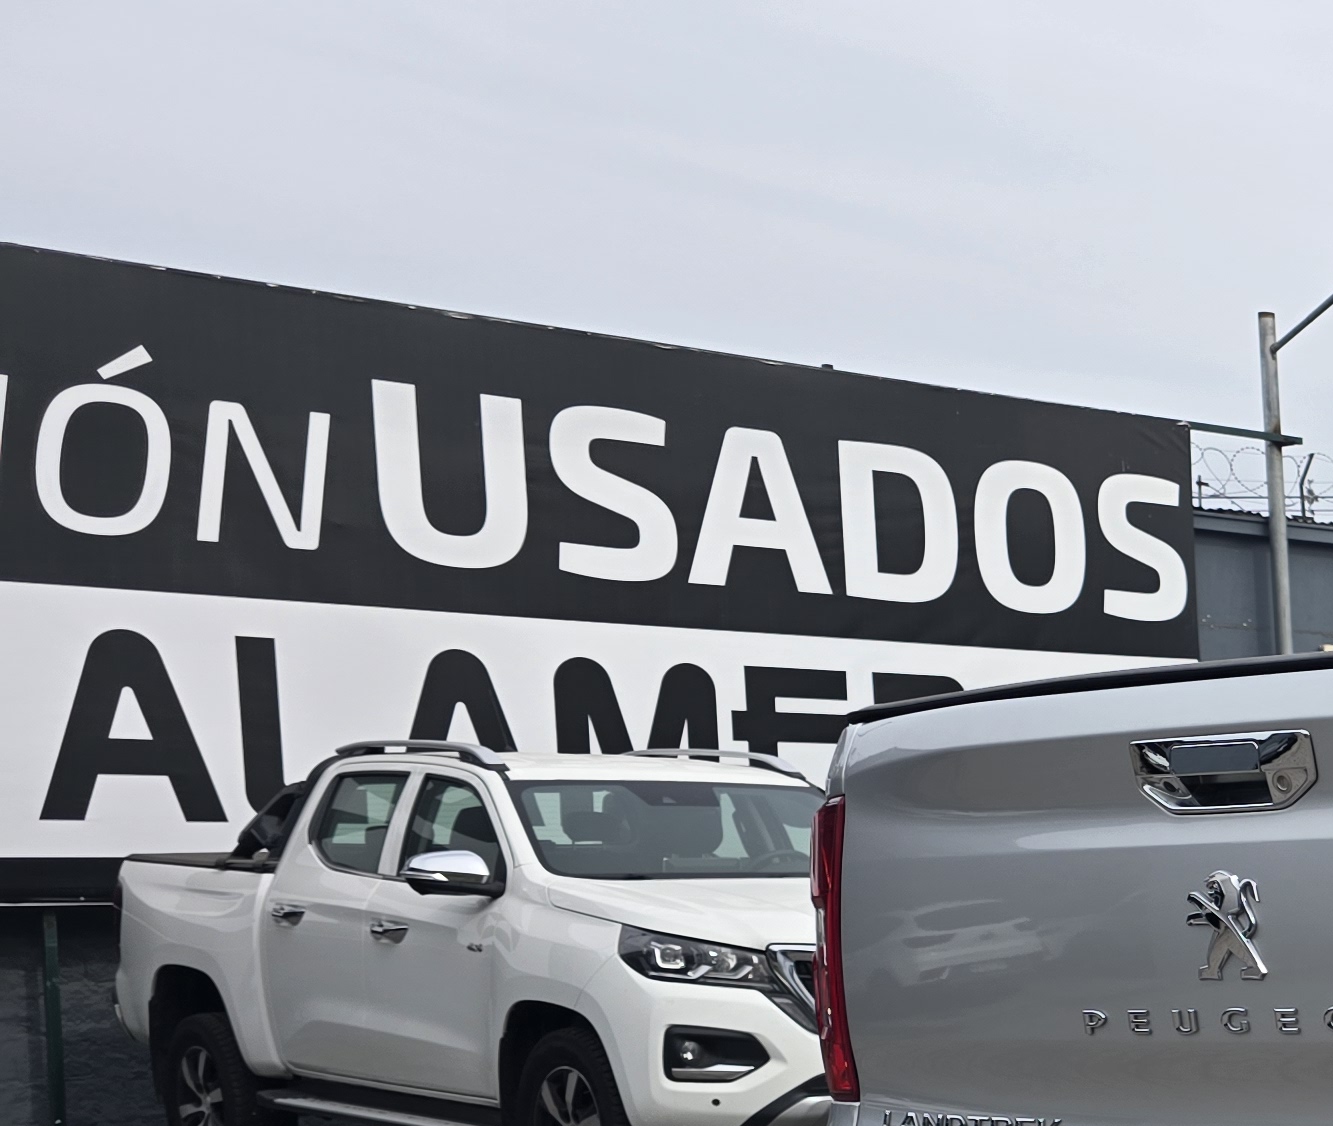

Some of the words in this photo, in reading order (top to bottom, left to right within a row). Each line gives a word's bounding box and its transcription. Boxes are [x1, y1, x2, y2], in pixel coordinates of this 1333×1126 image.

[0, 344, 330, 551] ÓN
[371, 378, 1190, 623] USADOS
[39, 628, 965, 823] ALAME
